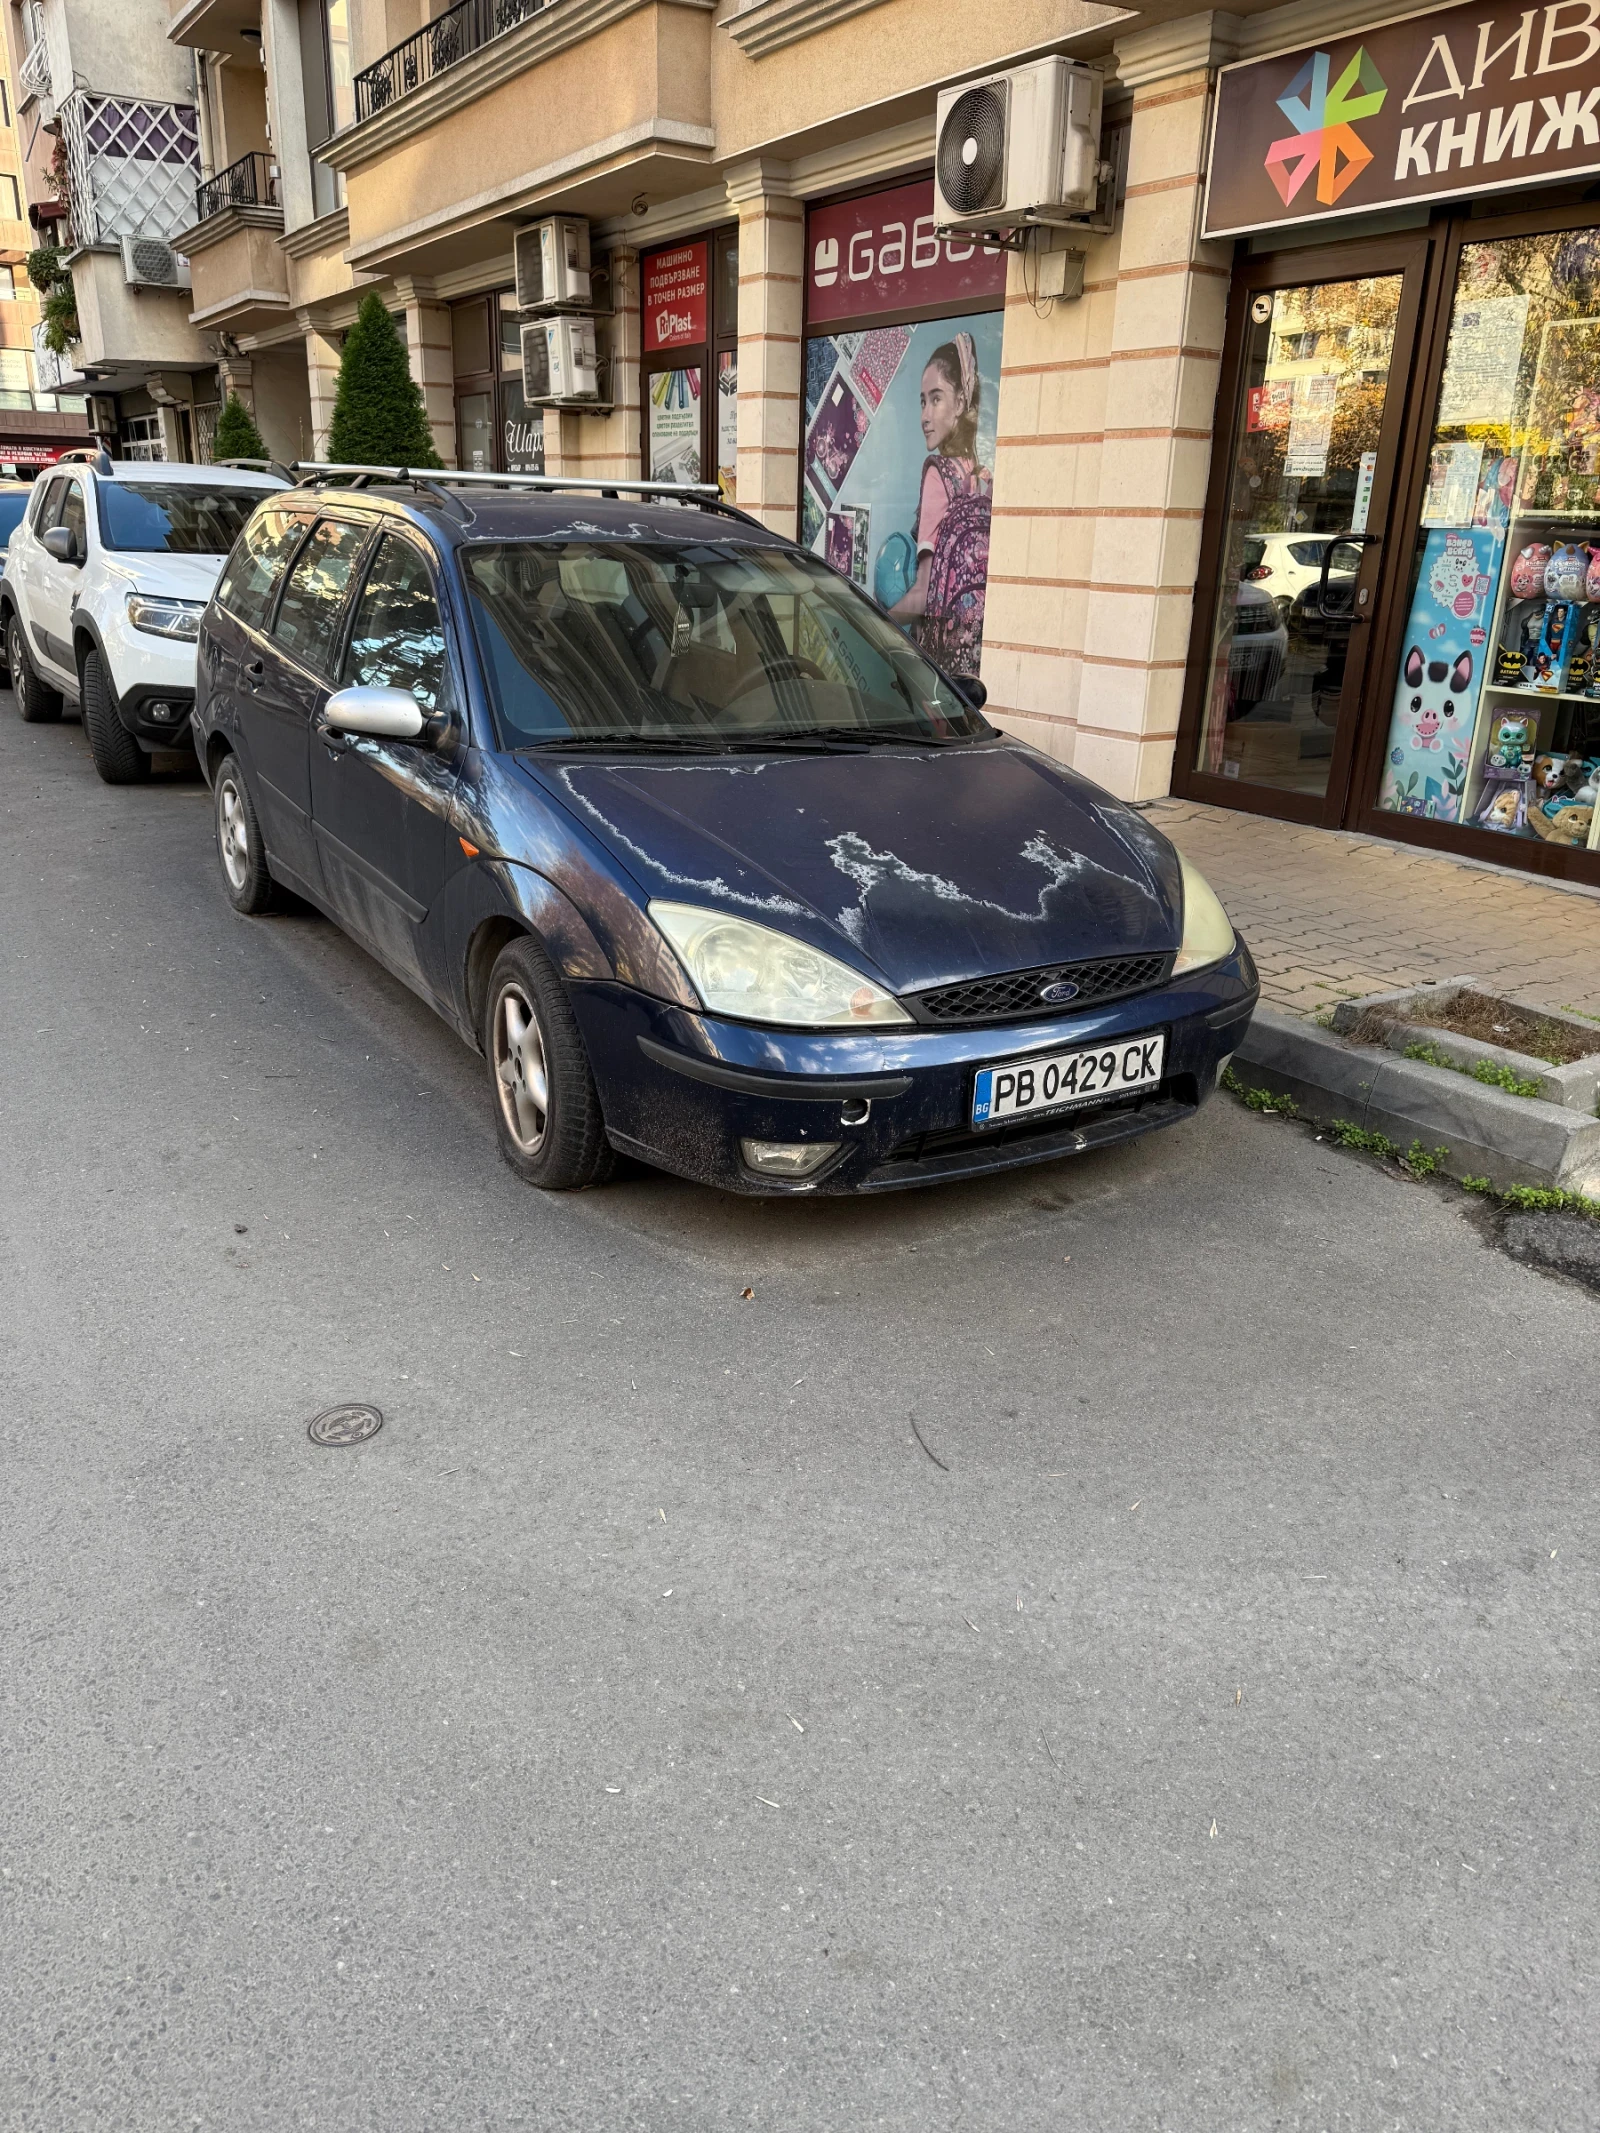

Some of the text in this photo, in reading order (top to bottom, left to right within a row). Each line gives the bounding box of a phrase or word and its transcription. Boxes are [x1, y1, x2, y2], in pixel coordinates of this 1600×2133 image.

[656, 249, 693, 270] МАШИННО
[649, 265, 700, 289] ПОДВЪРЗВАНЕ
[647, 282, 705, 306] В ТОЧЕН РАЗМЕР
[1050, 985, 1071, 999] Ford
[994, 1041, 1159, 1112] PB 0429 CK
[975, 1103, 990, 1116] BG
